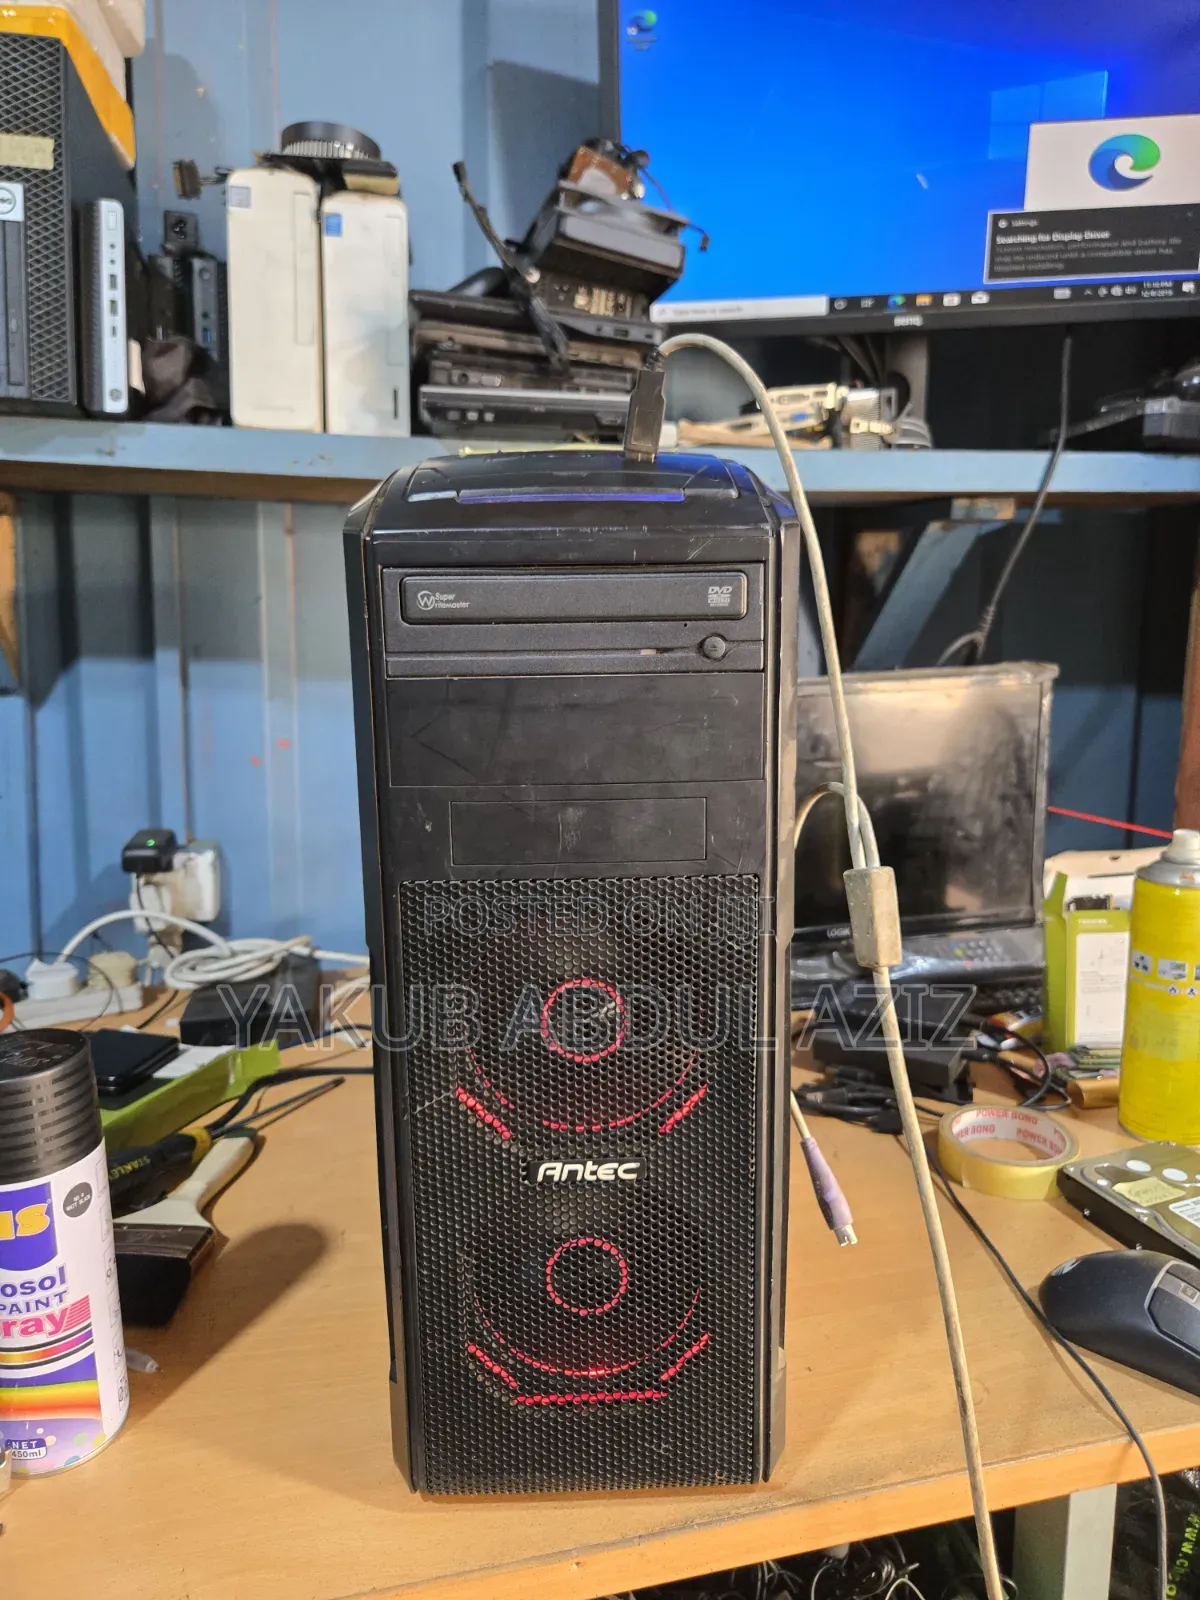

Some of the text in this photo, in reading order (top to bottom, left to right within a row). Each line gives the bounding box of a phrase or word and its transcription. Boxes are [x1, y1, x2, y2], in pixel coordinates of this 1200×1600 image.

[996, 230, 1110, 244] Searching for Display Driver
[708, 586, 733, 594] DVD
[435, 592, 456, 602] Super
[975, 1107, 1009, 1119] POWER
[1016, 1127, 1047, 1146] POWER
[0, 1307, 69, 1338] ray
[12, 1441, 37, 1449] NET
[12, 1449, 41, 1458] 450ml
